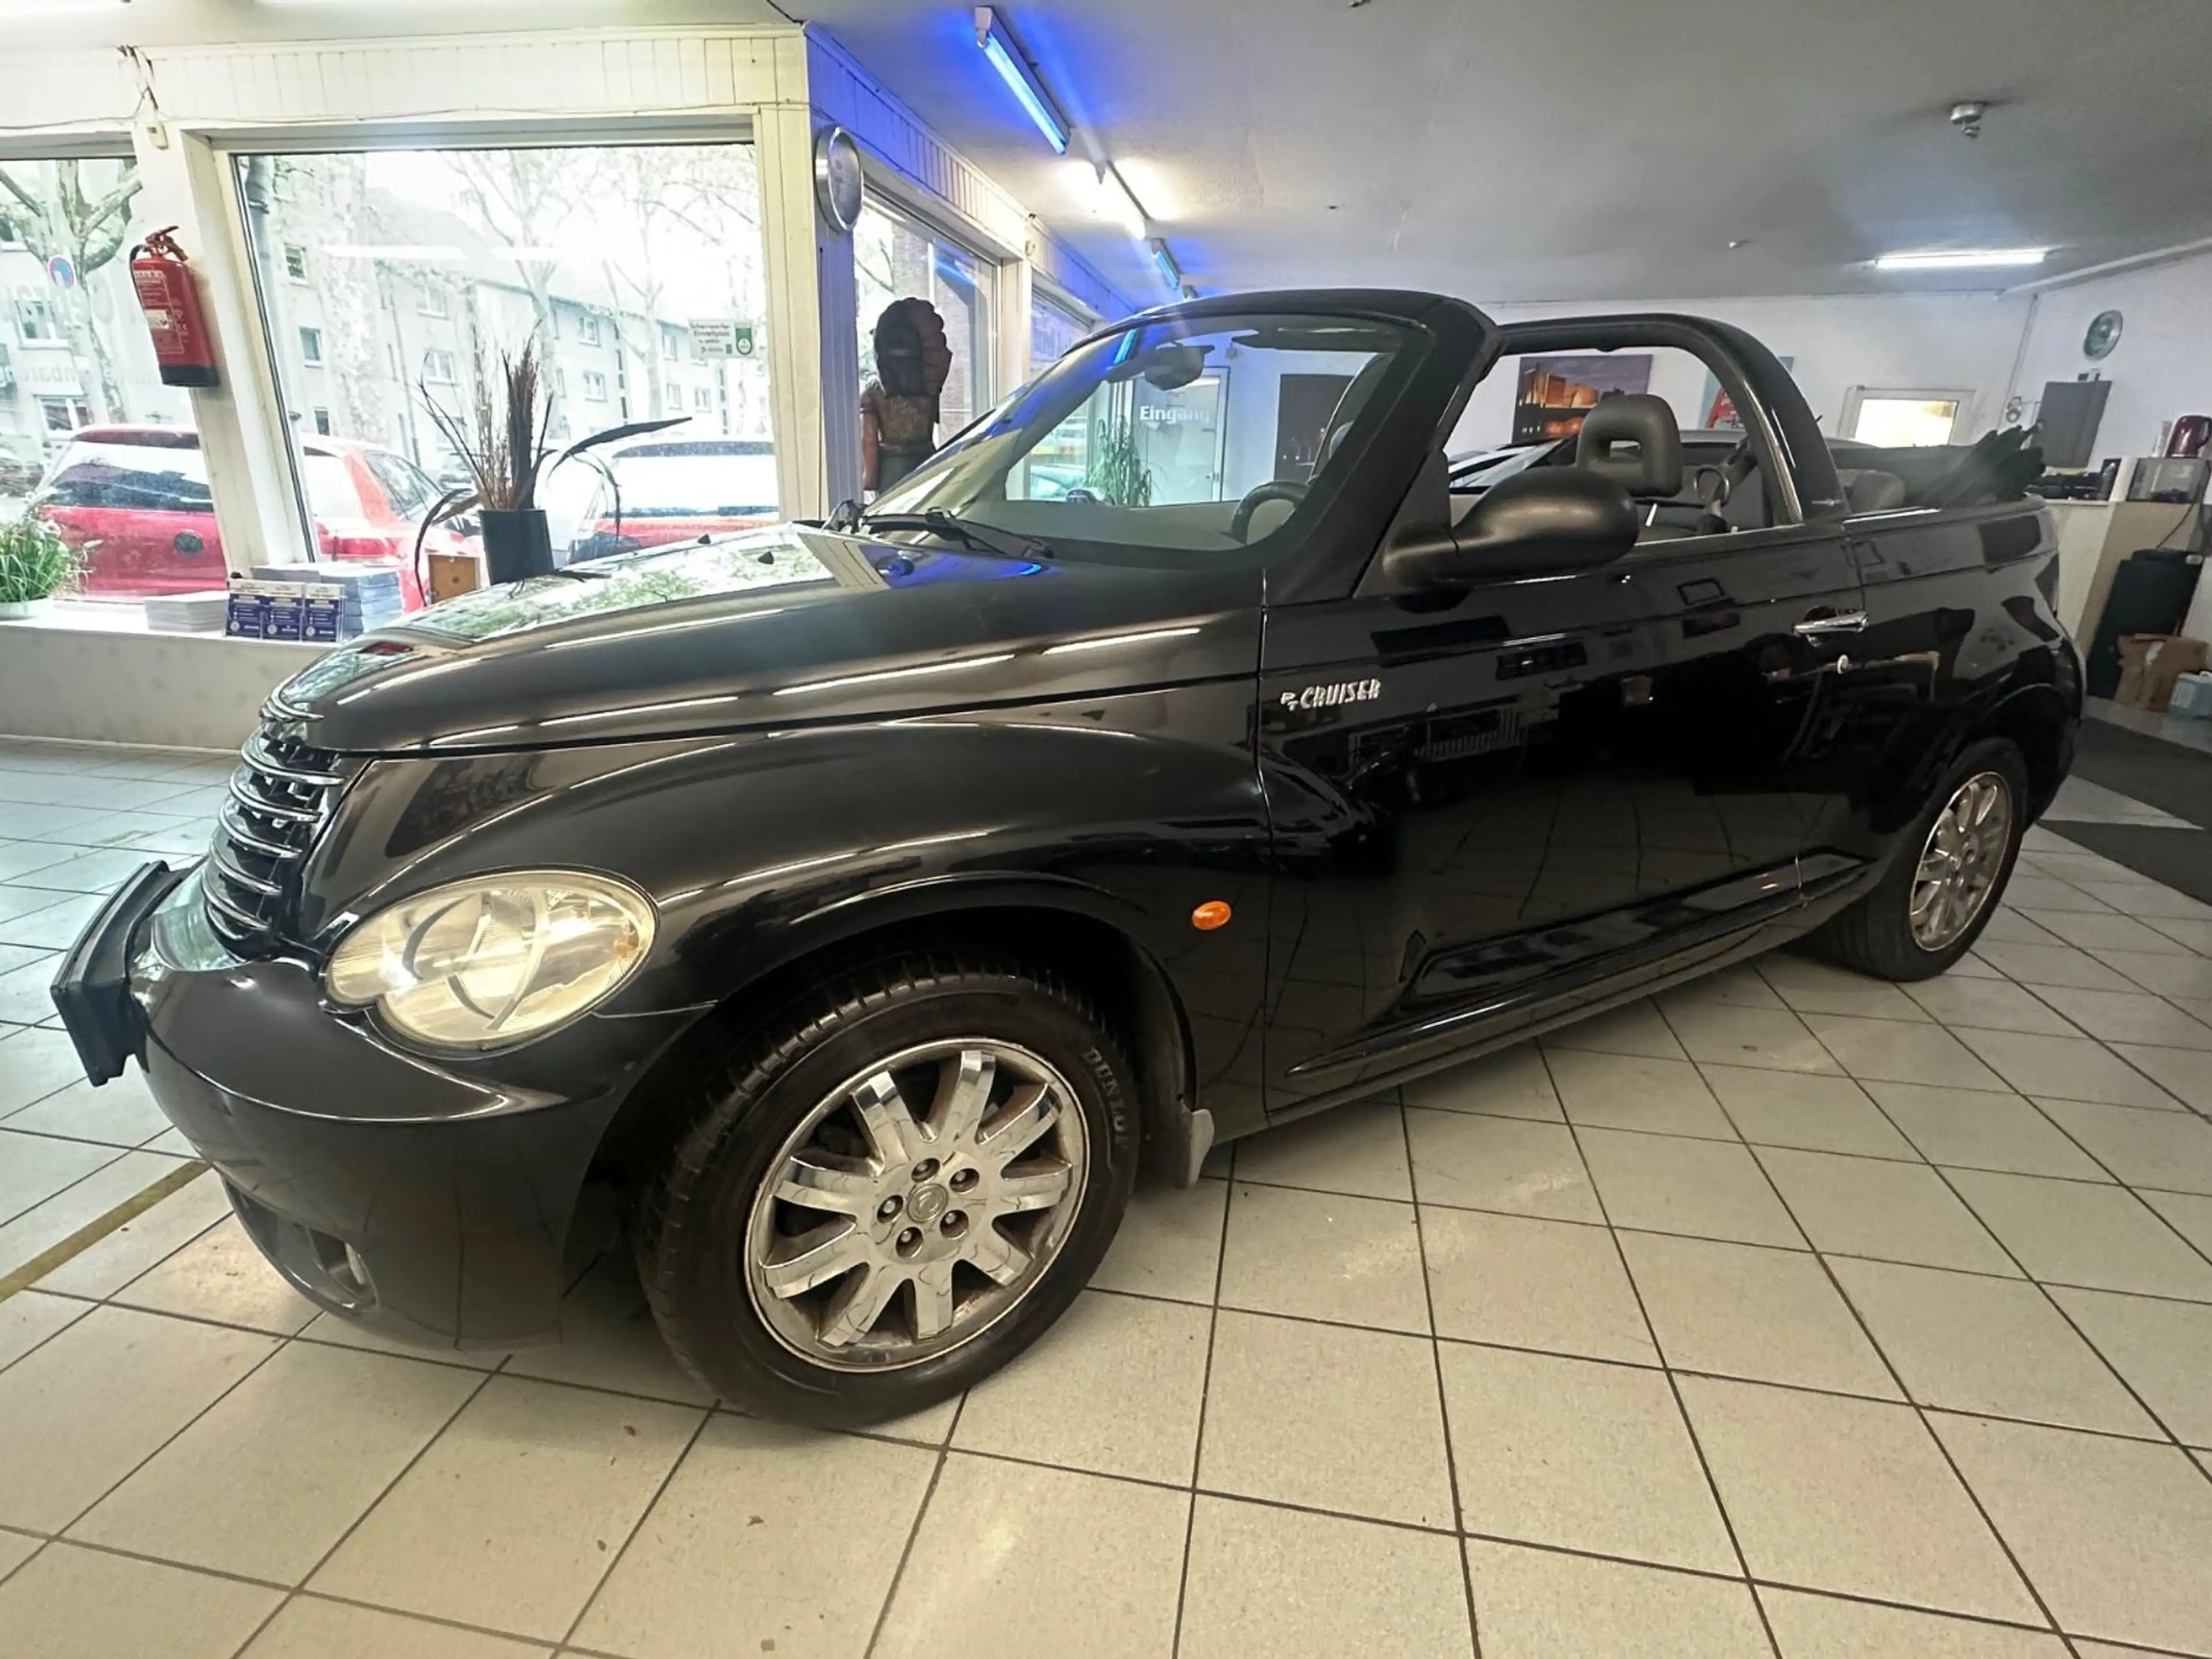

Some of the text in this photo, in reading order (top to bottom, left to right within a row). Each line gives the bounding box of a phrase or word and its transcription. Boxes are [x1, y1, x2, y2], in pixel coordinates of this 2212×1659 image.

[1139, 406, 1210, 425] Eingang
[1280, 678, 1382, 711] PT CRUISER
